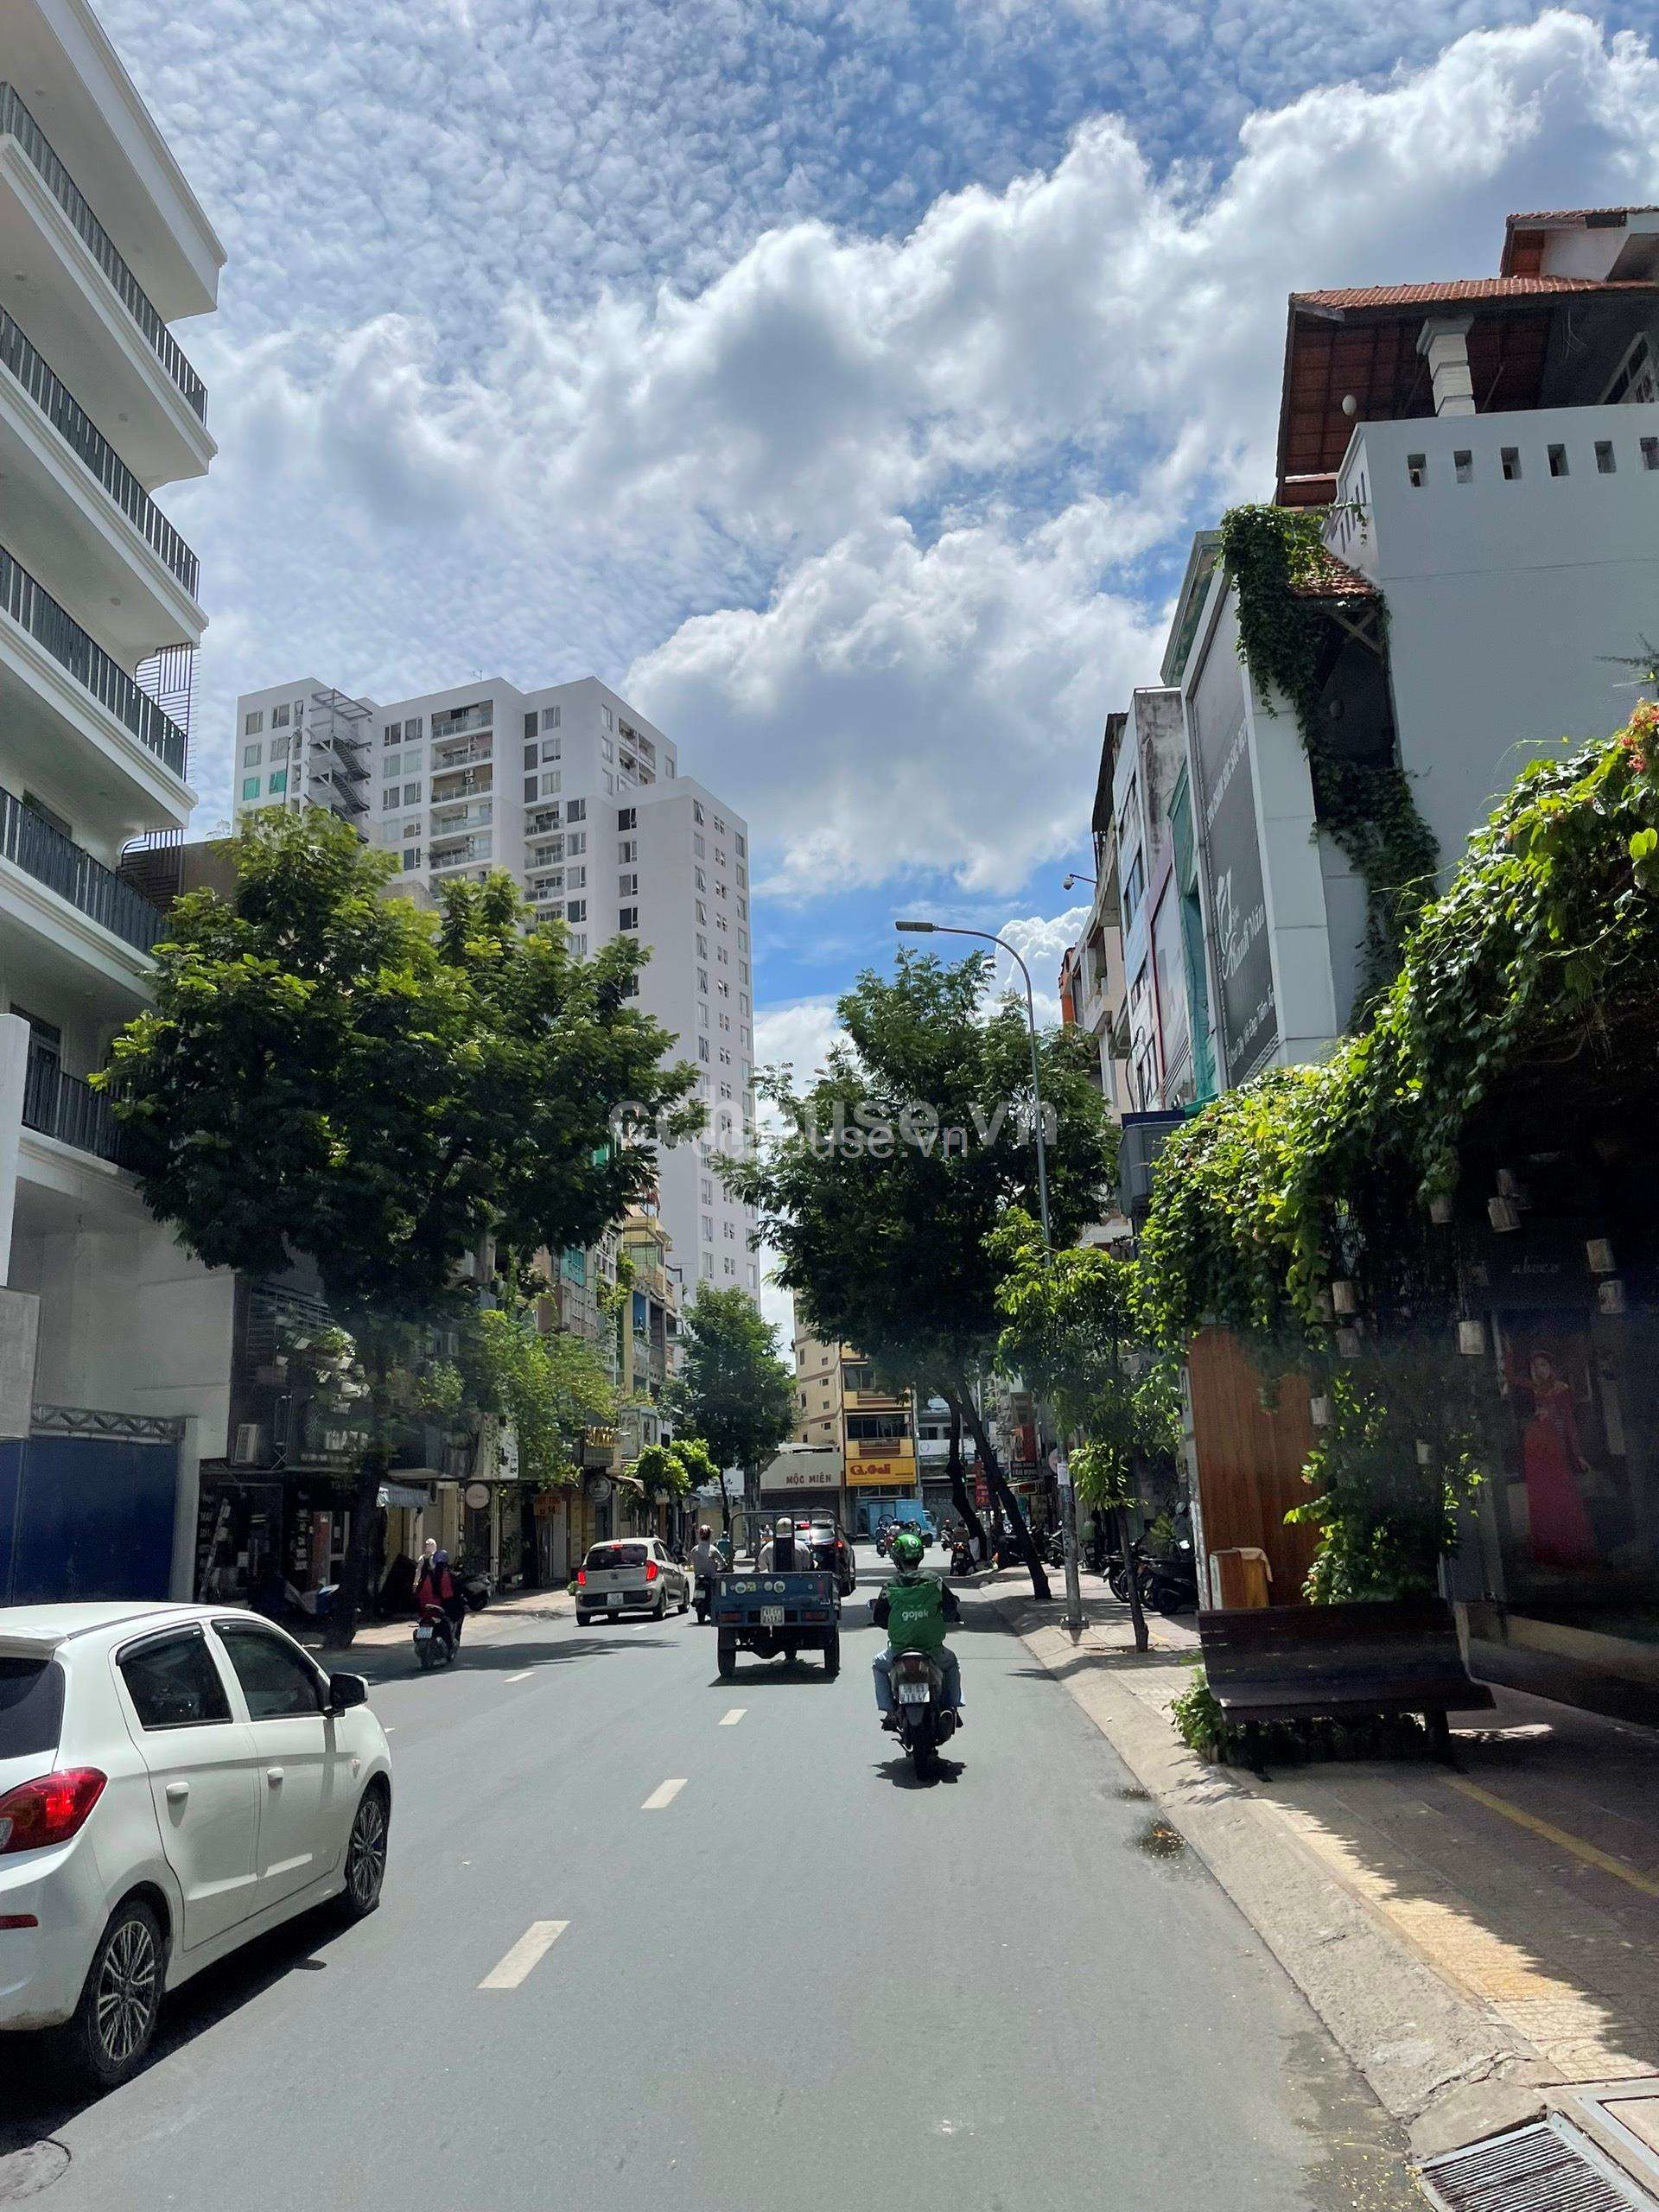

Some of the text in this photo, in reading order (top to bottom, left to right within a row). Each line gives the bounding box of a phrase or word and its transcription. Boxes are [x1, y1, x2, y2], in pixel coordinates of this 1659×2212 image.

[786, 1471, 832, 1486] MỘC MIÊN
[902, 1609, 929, 1622] gojek
